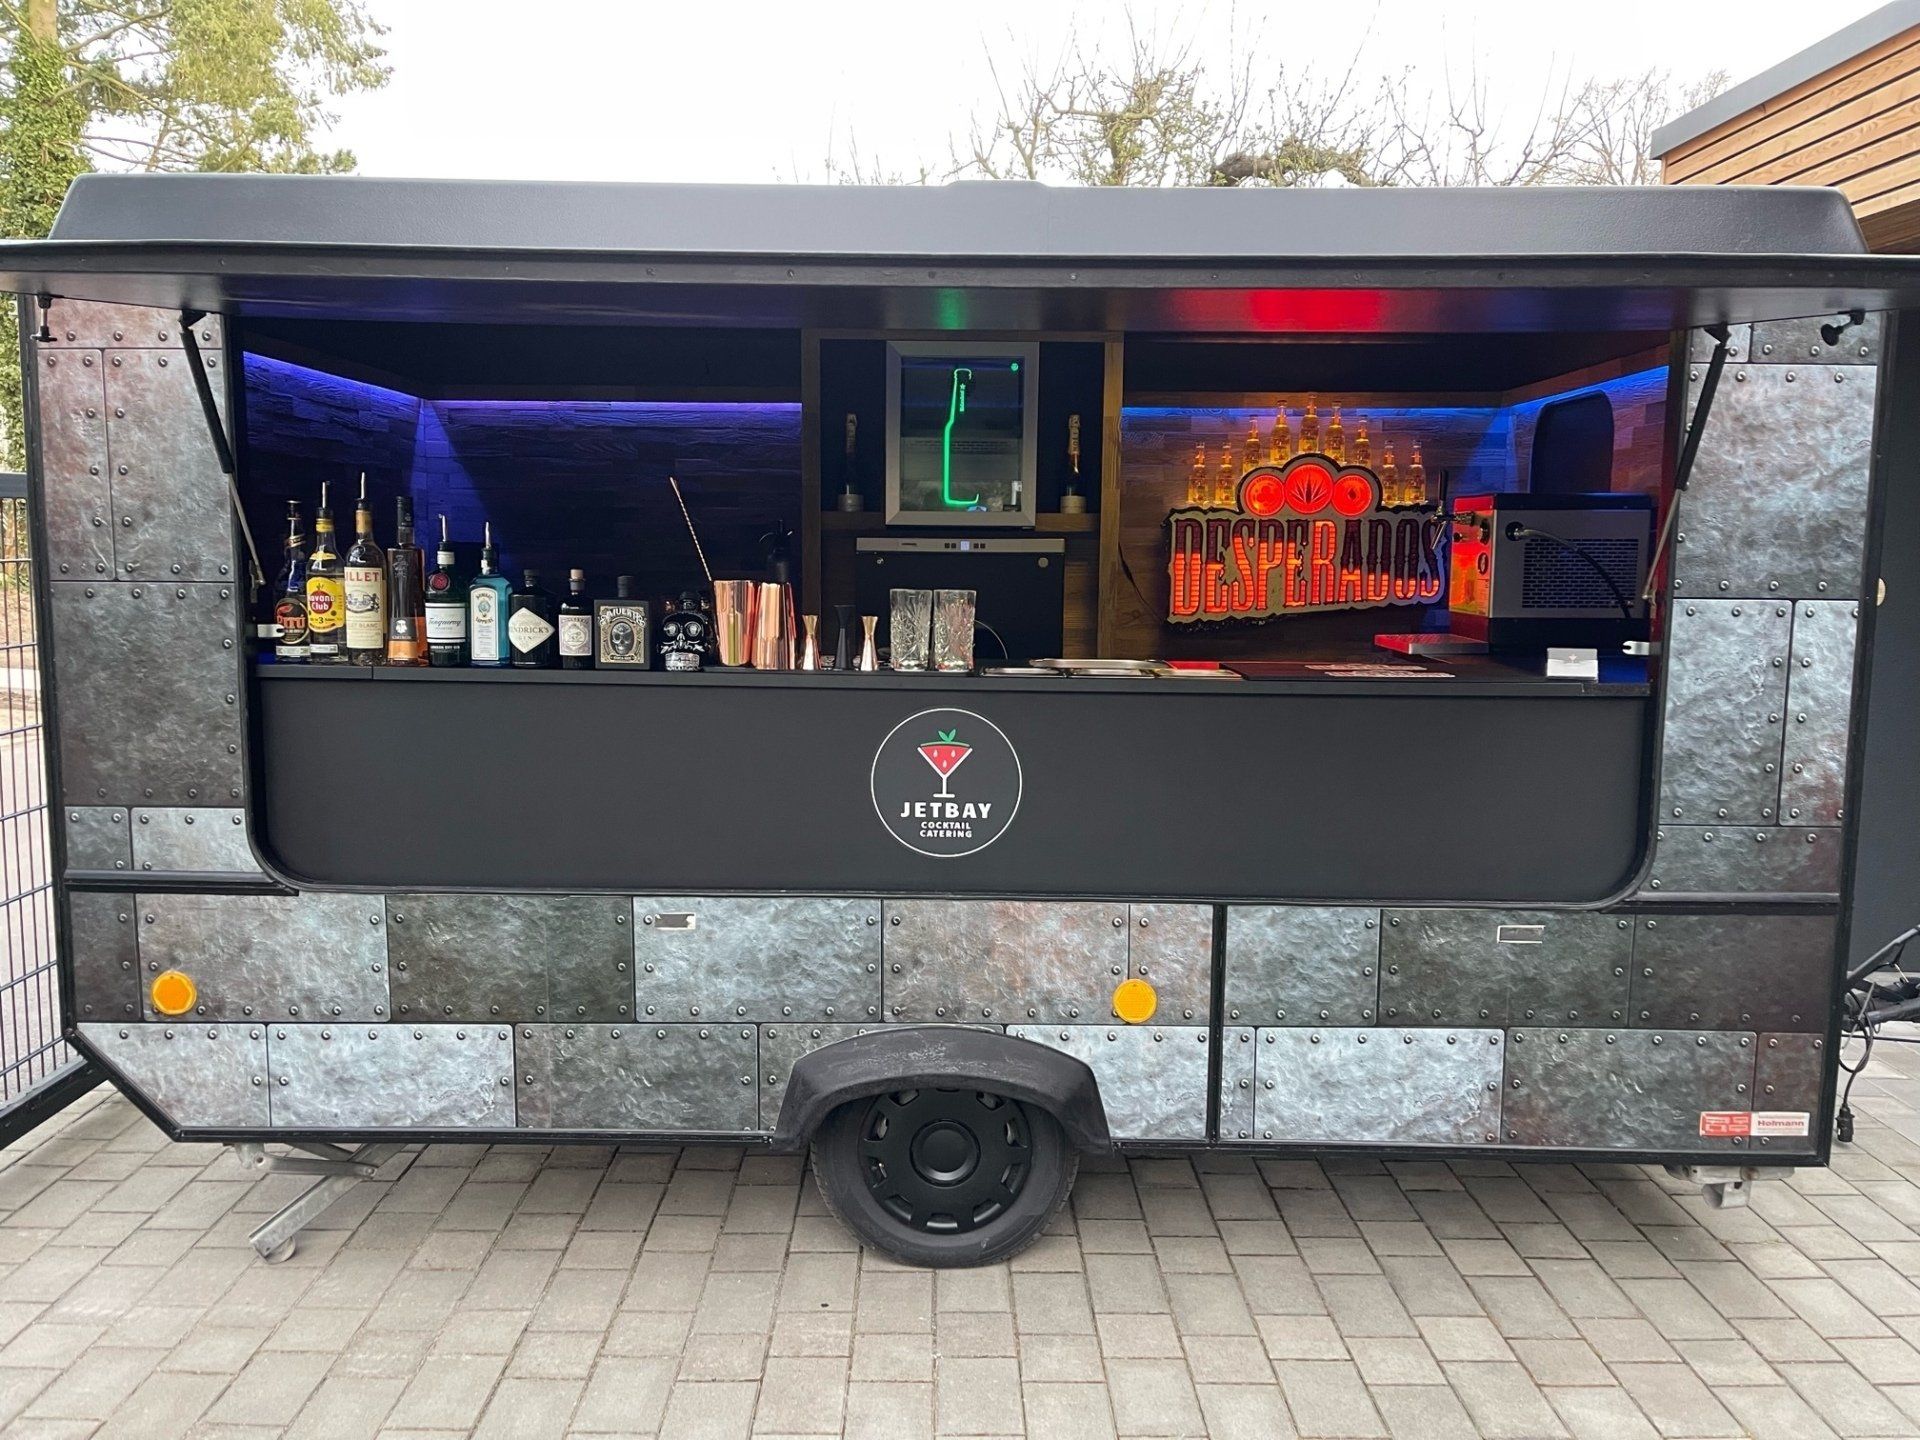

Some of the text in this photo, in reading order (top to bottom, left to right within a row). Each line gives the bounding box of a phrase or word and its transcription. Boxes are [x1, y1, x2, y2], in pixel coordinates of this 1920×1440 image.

[1172, 518, 1440, 615] DESPERADOS
[311, 602, 329, 610] Club
[900, 801, 992, 819] JETBAY
[920, 821, 972, 830] COCKTAIL
[919, 829, 973, 838] CATERING
